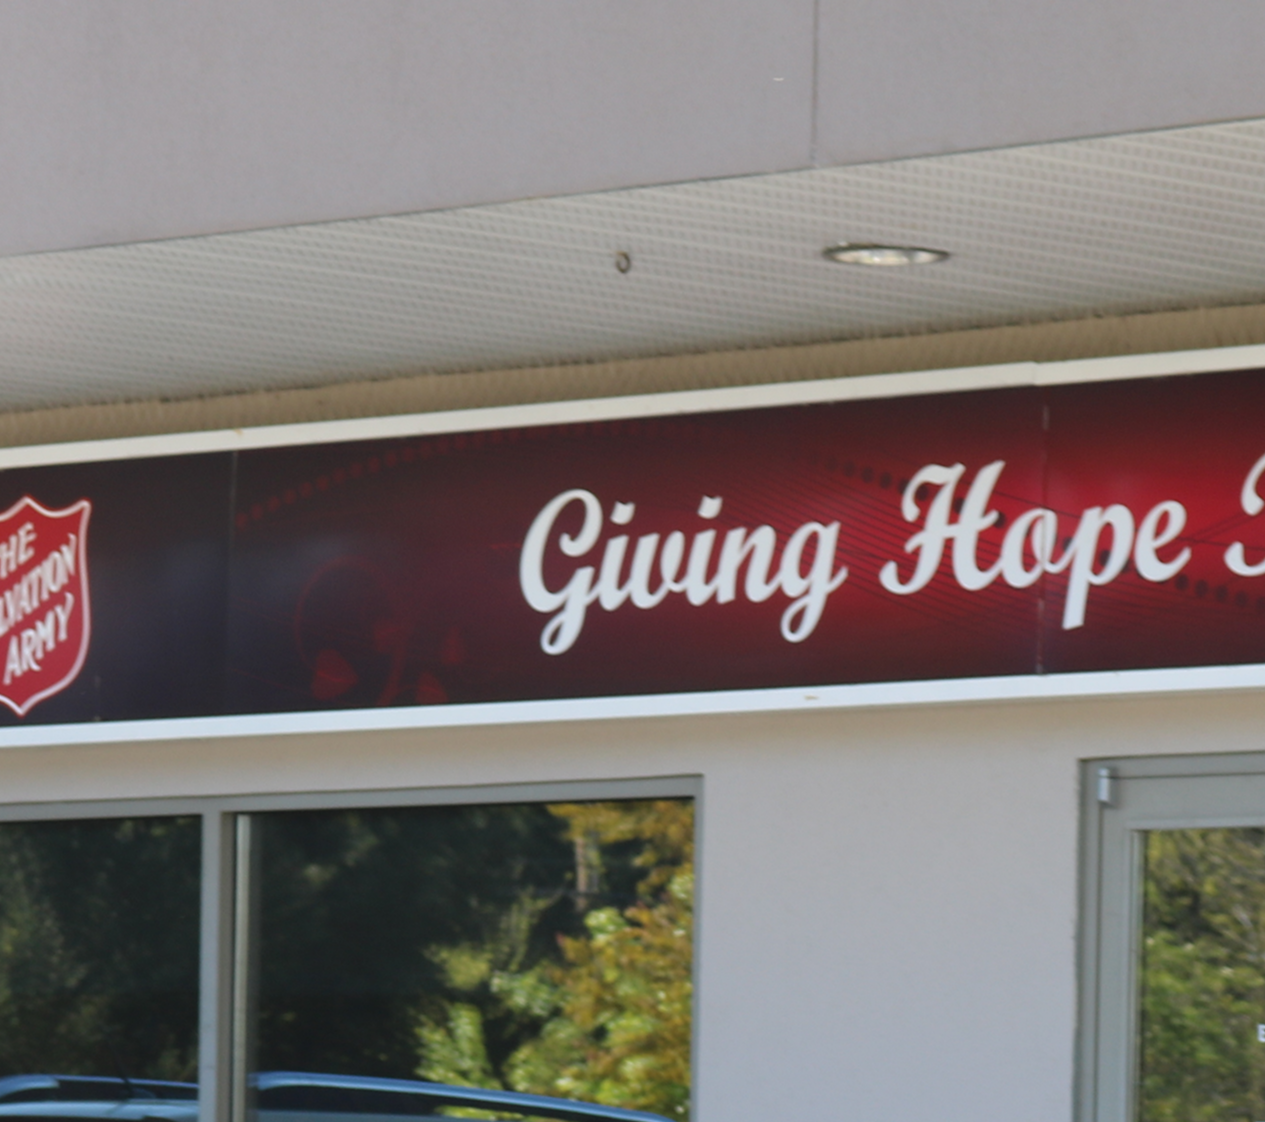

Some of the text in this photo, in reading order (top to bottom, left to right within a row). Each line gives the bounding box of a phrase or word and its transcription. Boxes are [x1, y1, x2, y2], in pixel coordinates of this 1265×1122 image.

[0, 521, 37, 580] HE
[0, 532, 77, 637] LVATION
[519, 489, 848, 655] Giving
[879, 460, 1191, 630] Hope
[3, 591, 75, 685] ARMY
